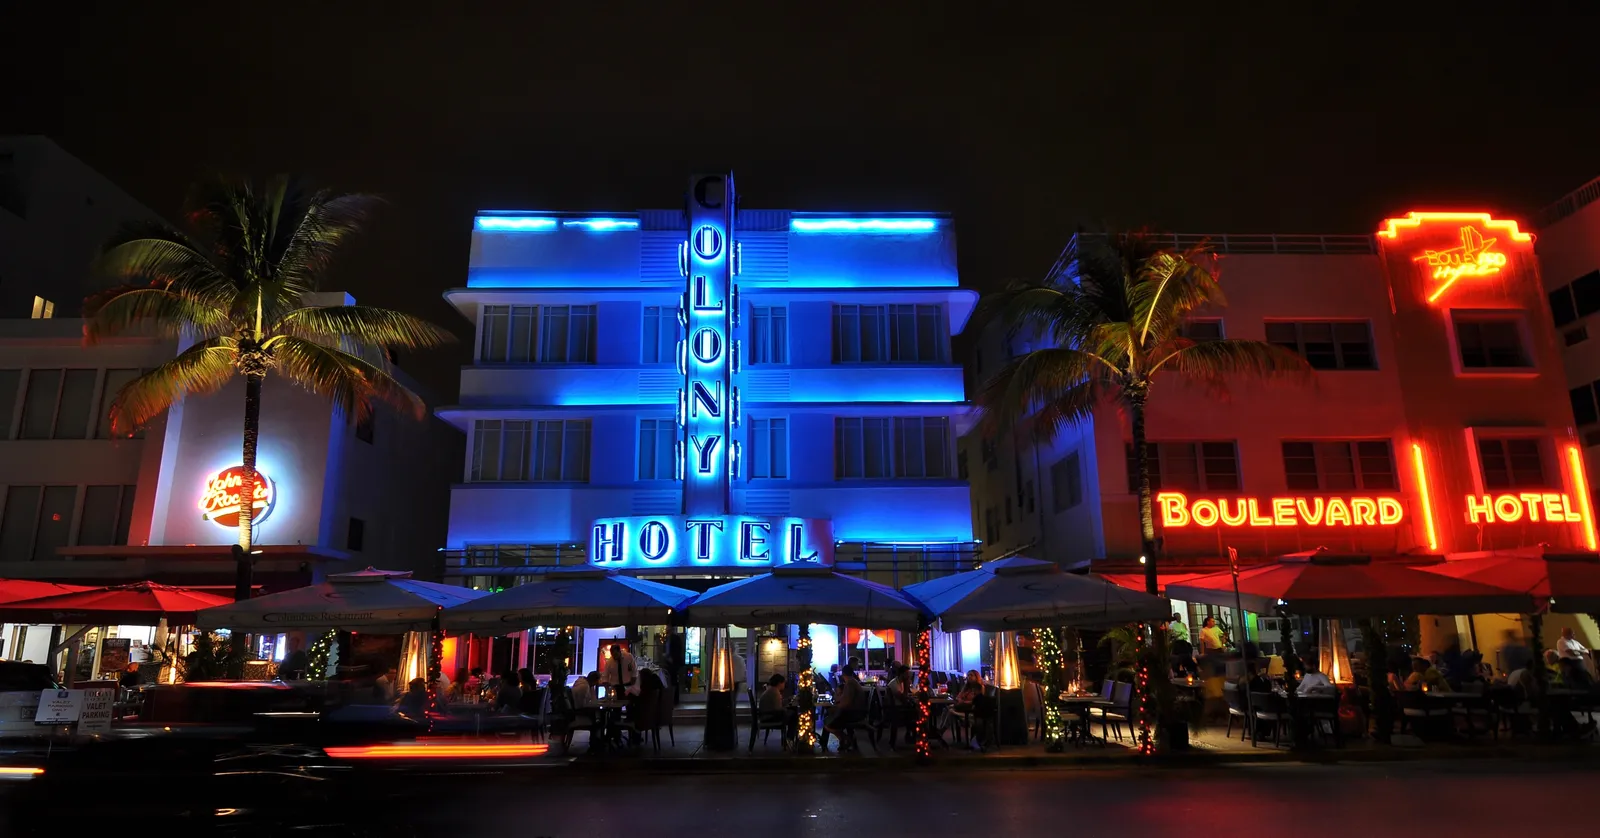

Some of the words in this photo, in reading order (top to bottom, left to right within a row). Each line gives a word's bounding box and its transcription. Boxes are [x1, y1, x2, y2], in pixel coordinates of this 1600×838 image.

[690, 175, 724, 474] COLONY
[1157, 492, 1403, 527] BOULEVARD
[1467, 493, 1582, 522] HOTEL
[593, 520, 818, 563] HOTEL
[262, 612, 317, 623] Columbus
[82, 711, 110, 719] PARKING
[86, 702, 106, 710] VALET
